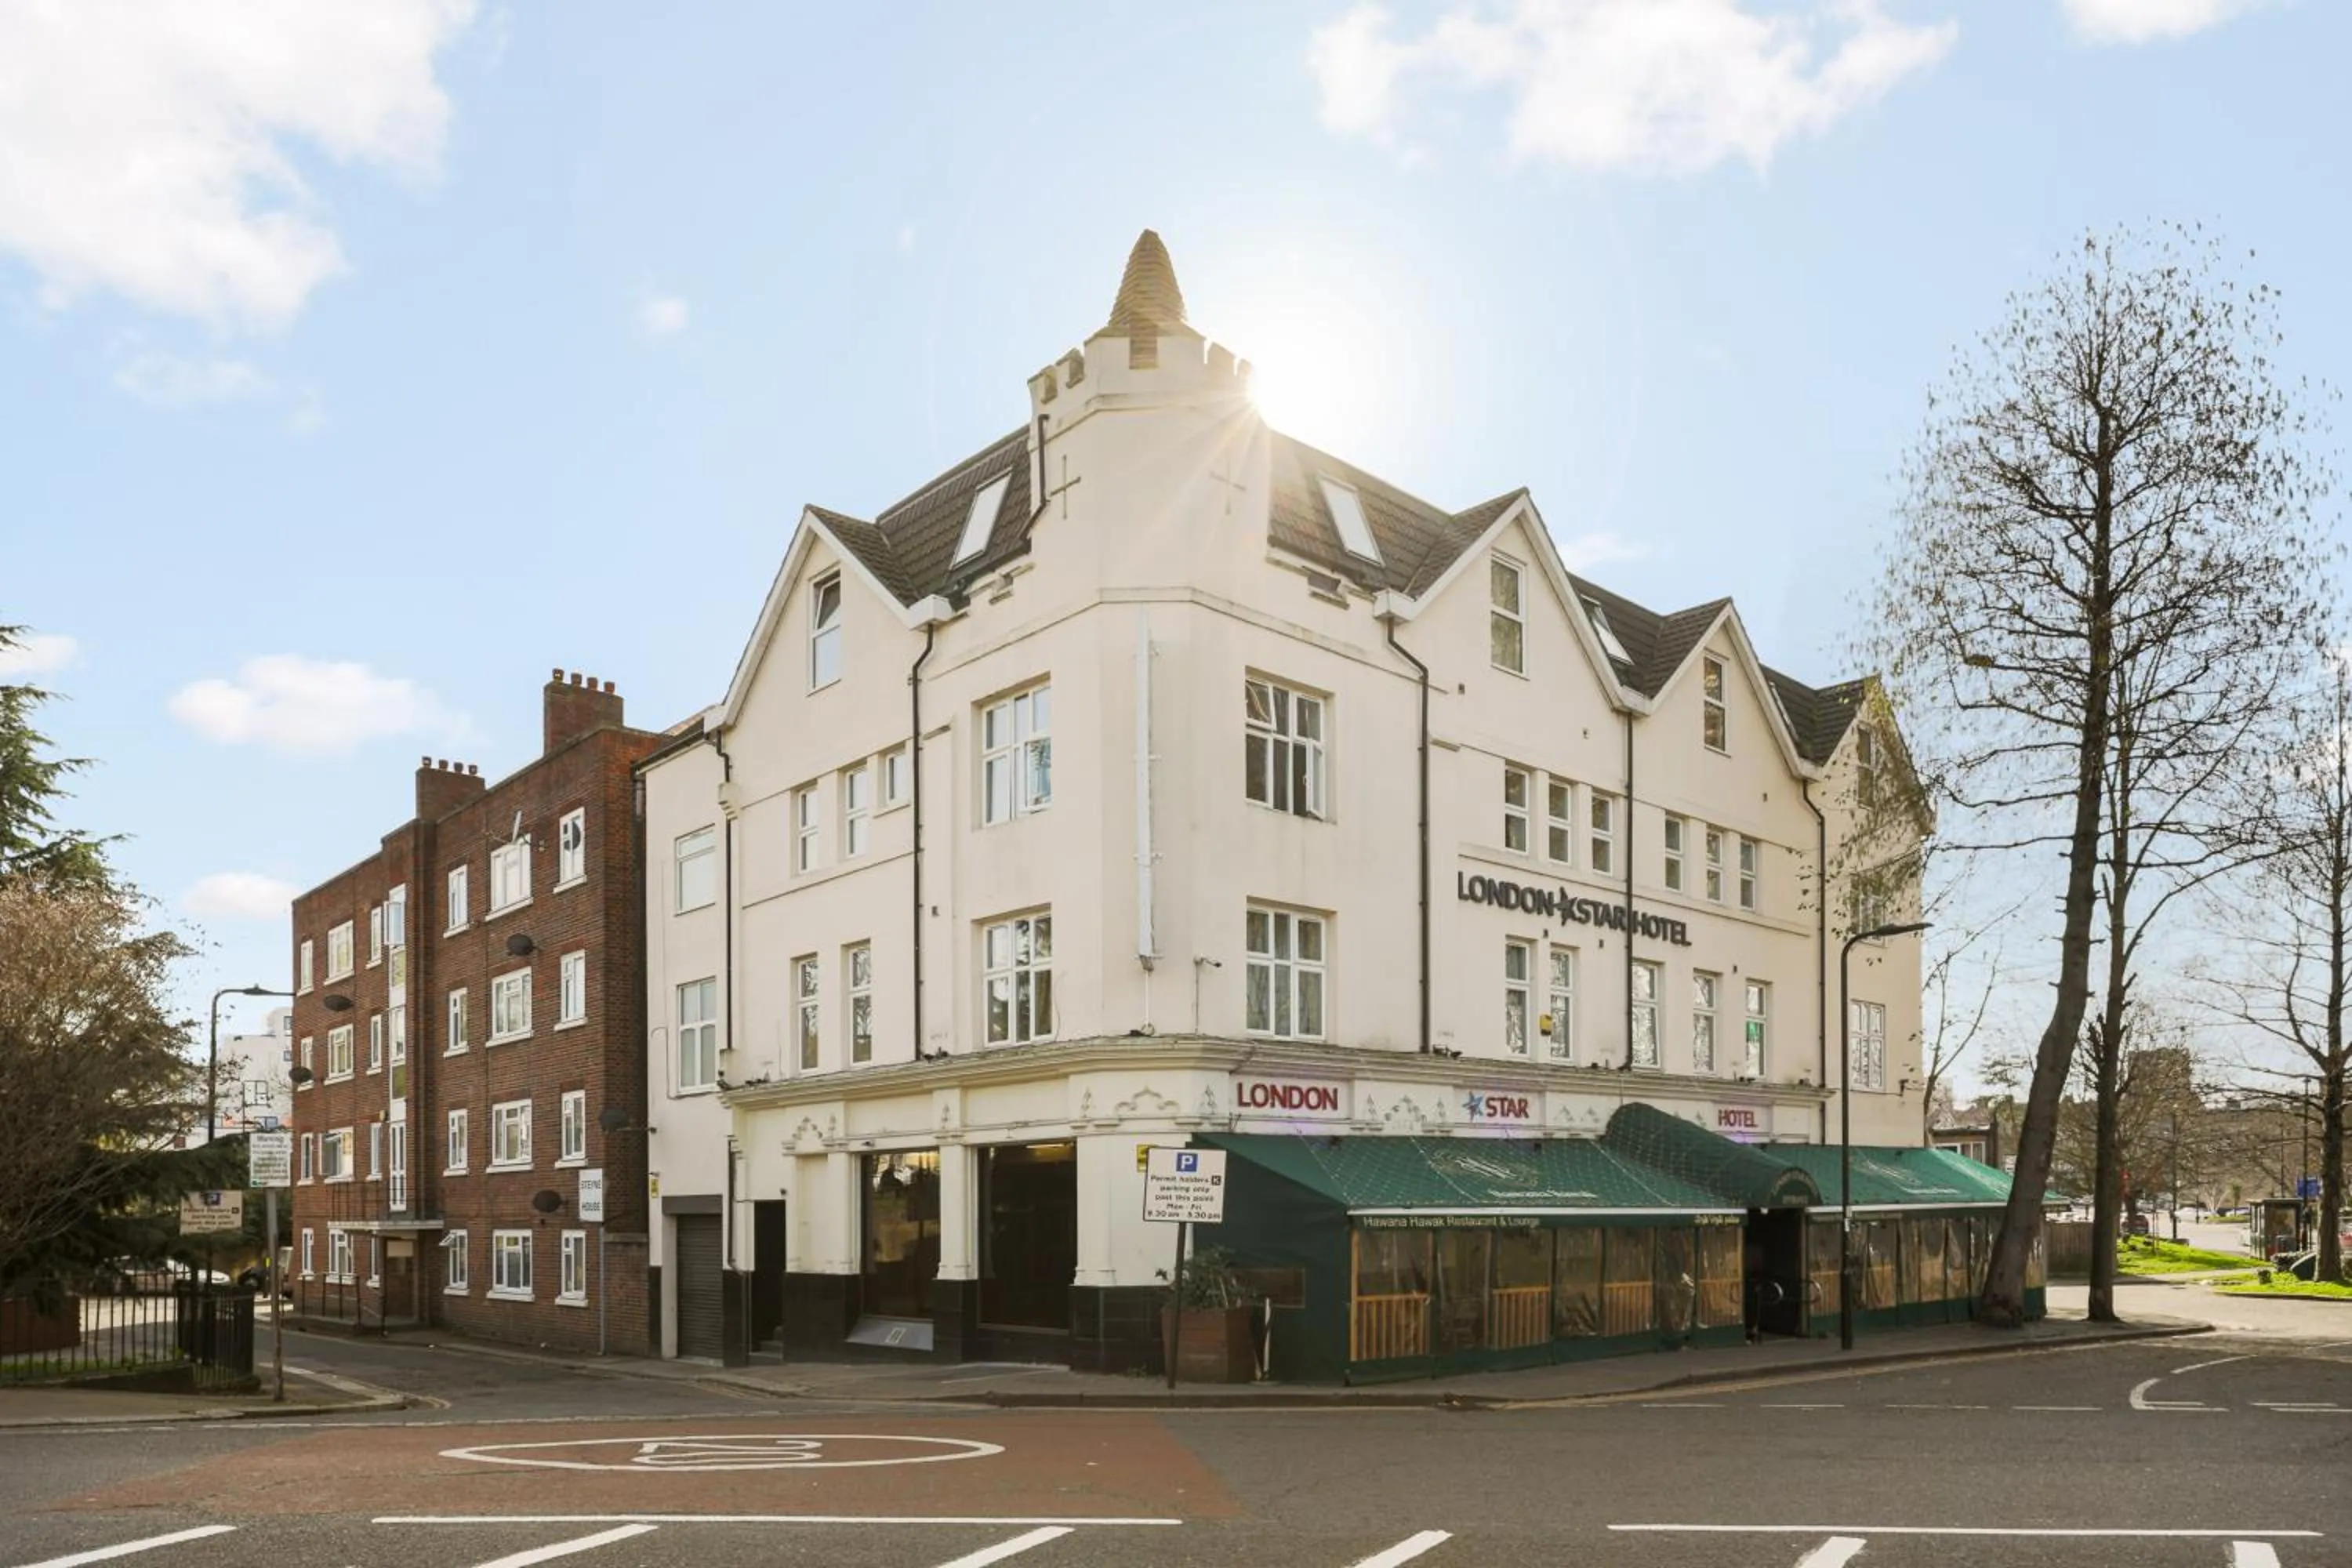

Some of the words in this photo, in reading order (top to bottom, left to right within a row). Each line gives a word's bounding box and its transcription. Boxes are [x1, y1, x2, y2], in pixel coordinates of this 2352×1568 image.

[1457, 871, 1554, 916] LONDON
[1576, 898, 1627, 931] STAR
[1632, 909, 1692, 946] HOTEL
[1236, 1082, 1338, 1111] LONDON
[1485, 1097, 1530, 1119] STAR
[1718, 1109, 1759, 1127] HOTEL
[1181, 1154, 1193, 1171] P
[1160, 1185, 1190, 1193] parking
[582, 1201, 602, 1211] HOUSE
